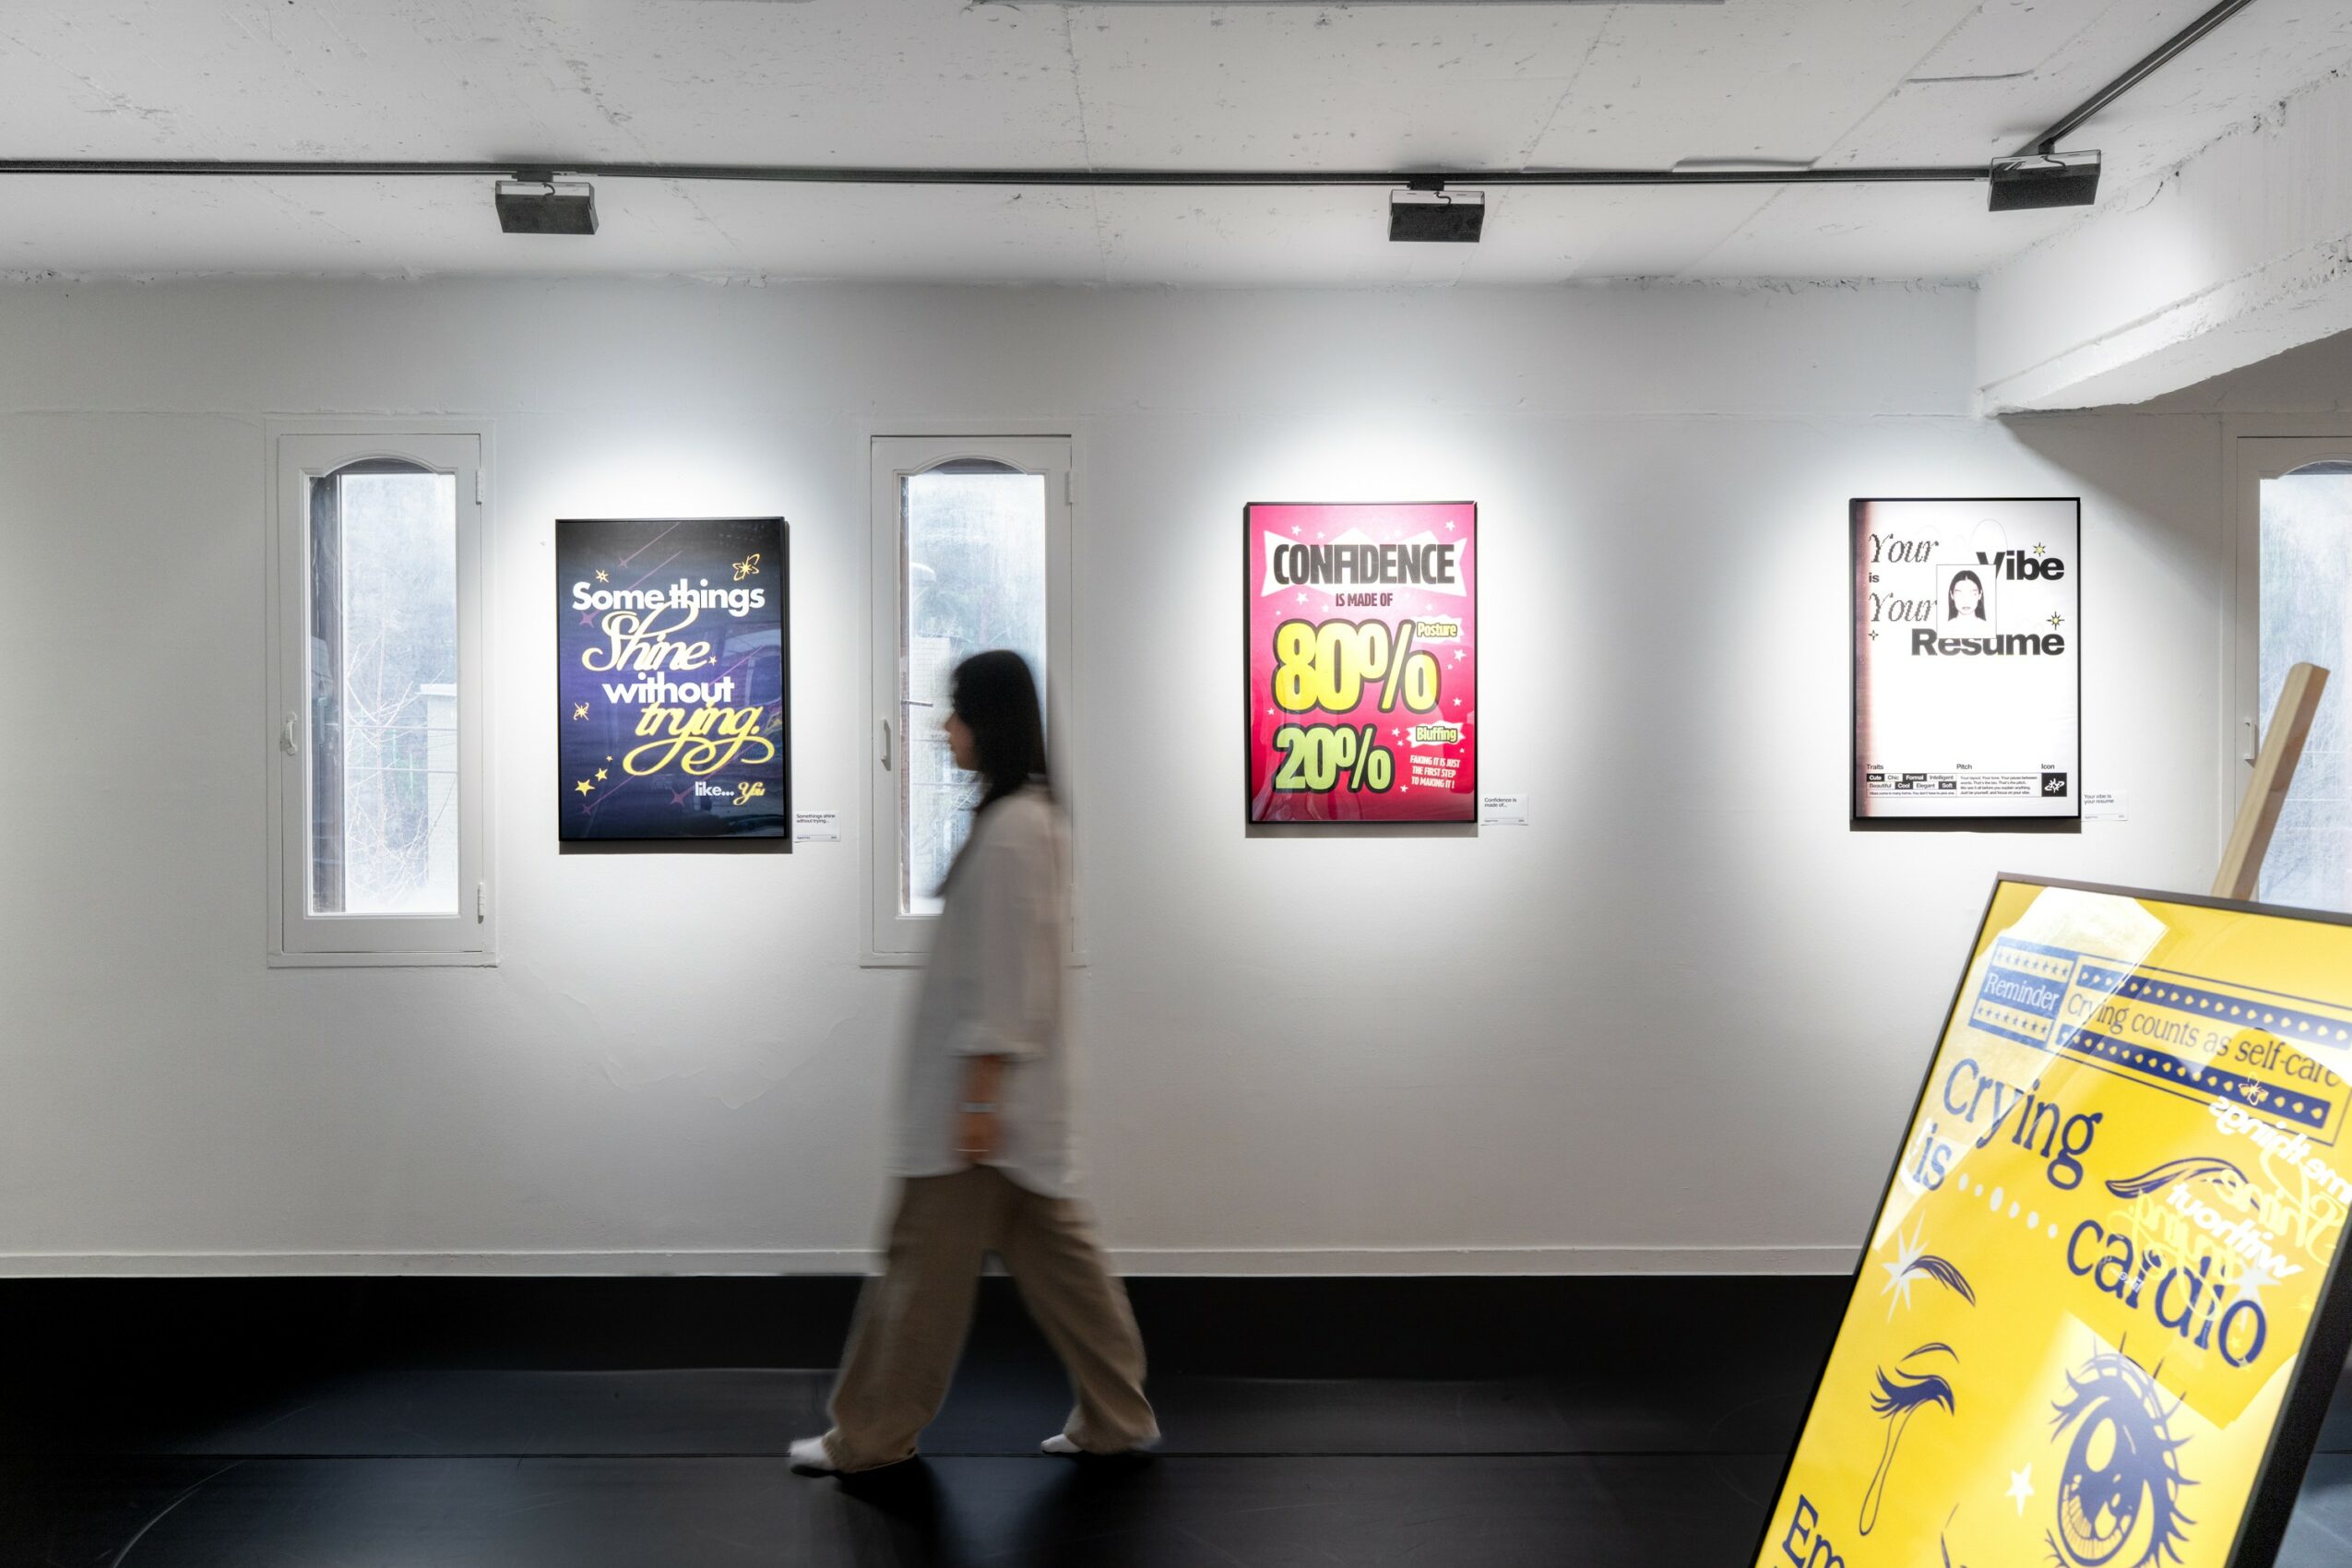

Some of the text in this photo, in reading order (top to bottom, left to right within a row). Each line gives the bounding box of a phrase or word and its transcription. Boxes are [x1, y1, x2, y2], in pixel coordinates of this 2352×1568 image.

[1868, 533, 1940, 564] Your
[1274, 544, 1455, 585] CONFIDENCE
[1868, 572, 1880, 583] is
[1976, 550, 2065, 581] Vibe
[1336, 593, 1393, 607] IS MADE OF
[1868, 592, 1937, 623] Your
[582, 600, 710, 671] Shine
[1416, 622, 1458, 637] Posture
[1911, 627, 2065, 656] Resume
[1271, 618, 1442, 715] 80%
[601, 671, 735, 704] without
[623, 701, 775, 776] trying.
[1416, 725, 1458, 743] Bluffing
[1274, 723, 1395, 794] 20%
[1409, 754, 1461, 768] FAKING IT IS JUST
[1412, 766, 1456, 778] THE FIRST STEP
[695, 781, 766, 805] like... You
[1411, 776, 1420, 785] TO
[1420, 777, 1444, 788] MAKING
[1983, 973, 2060, 1012] Reminder
[2068, 993, 2131, 1034] Crying
[2132, 1012, 2201, 1048] counts
[2204, 1029, 2229, 1057] as
[1943, 1058, 2104, 1191] Crying
[1912, 1123, 1953, 1191] is
[2067, 1218, 2267, 1368] cardio
